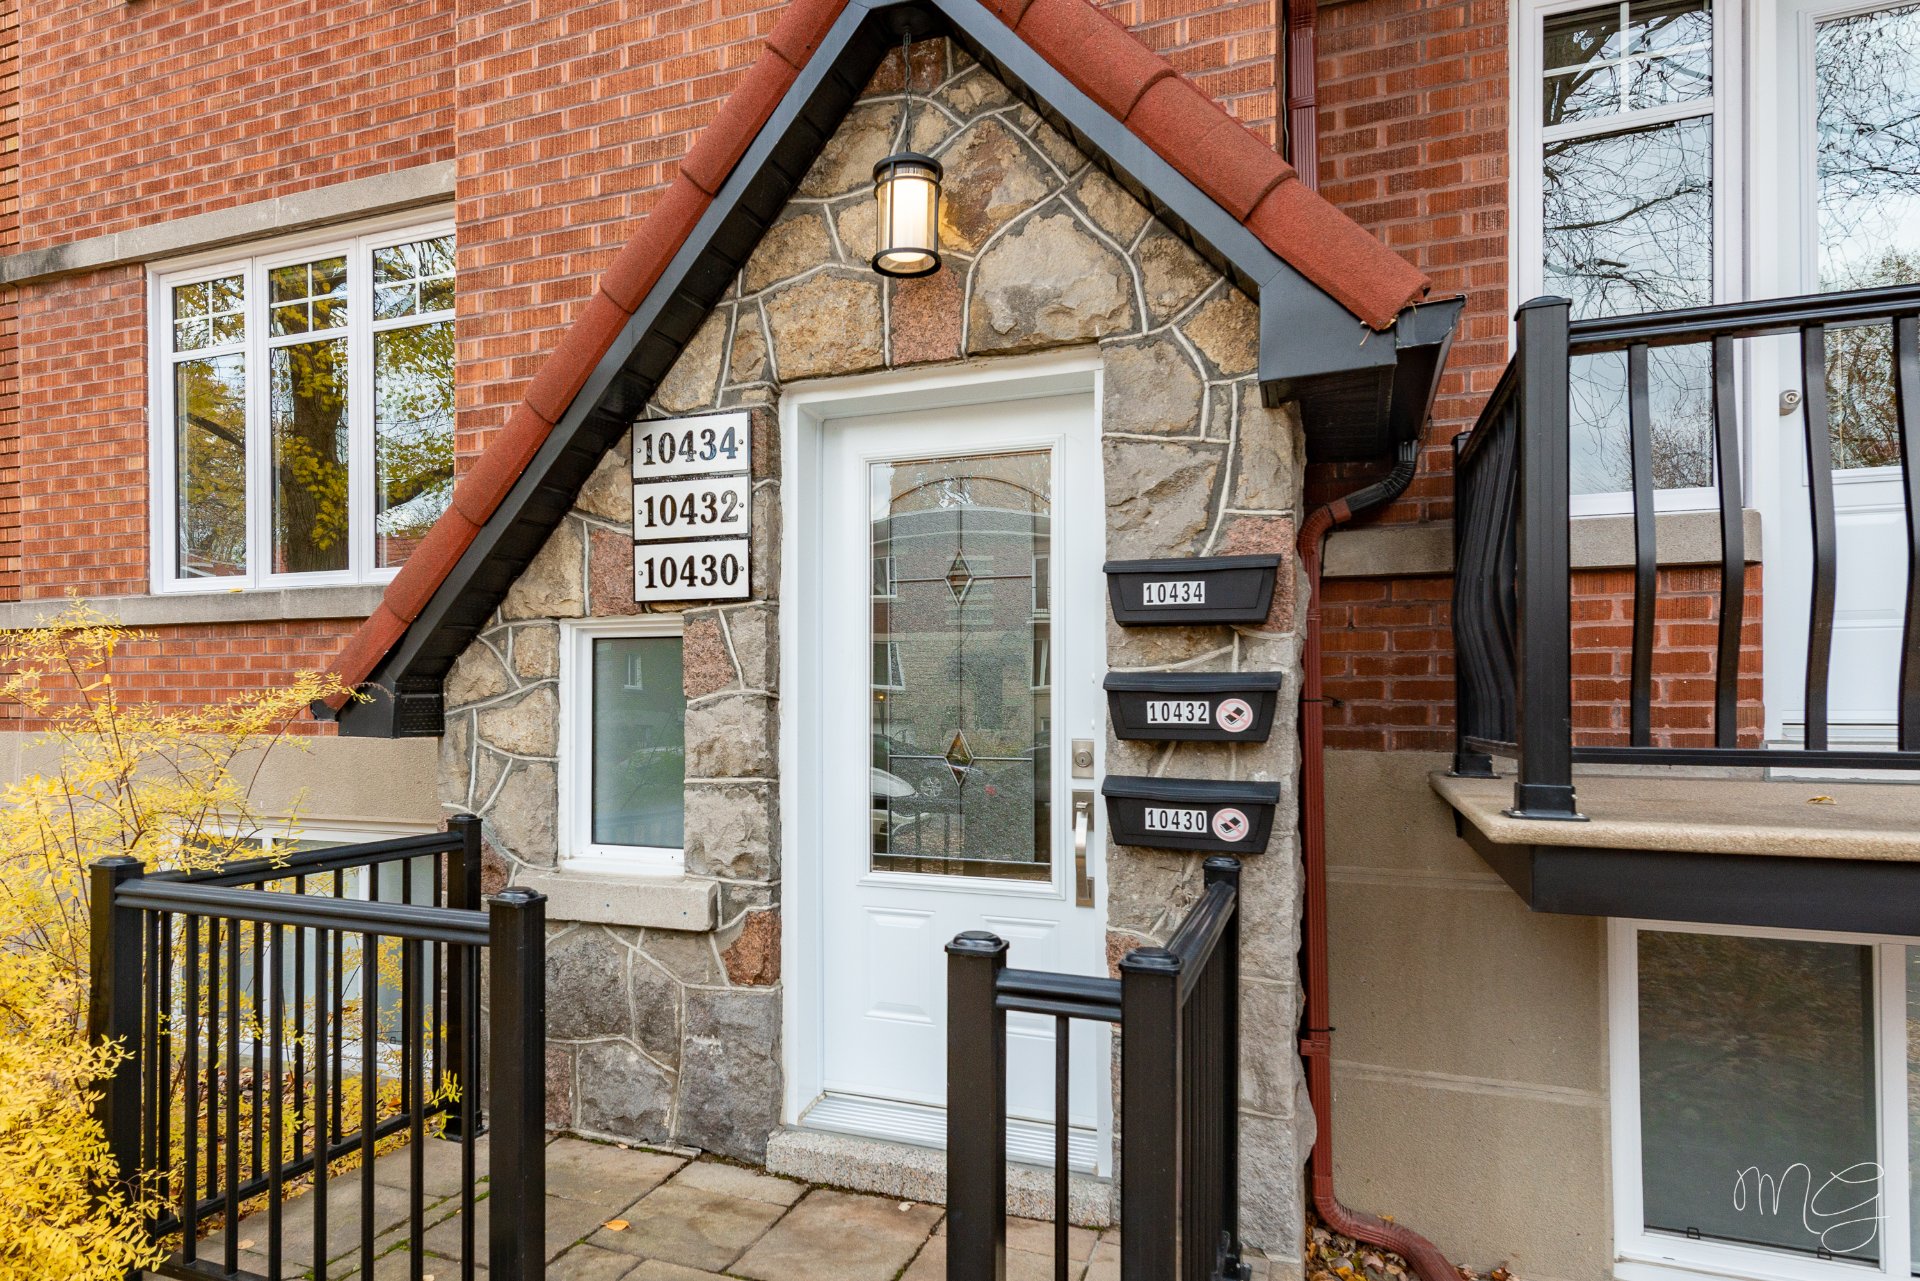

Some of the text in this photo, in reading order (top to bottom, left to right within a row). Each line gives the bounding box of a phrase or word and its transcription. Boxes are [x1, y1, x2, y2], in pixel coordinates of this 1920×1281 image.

[642, 426, 739, 466] 10434
[643, 489, 739, 528] 10432
[644, 553, 739, 589] 10430
[1145, 582, 1203, 604] 10434
[1149, 702, 1207, 722] 10432
[1147, 809, 1205, 832] 10430
